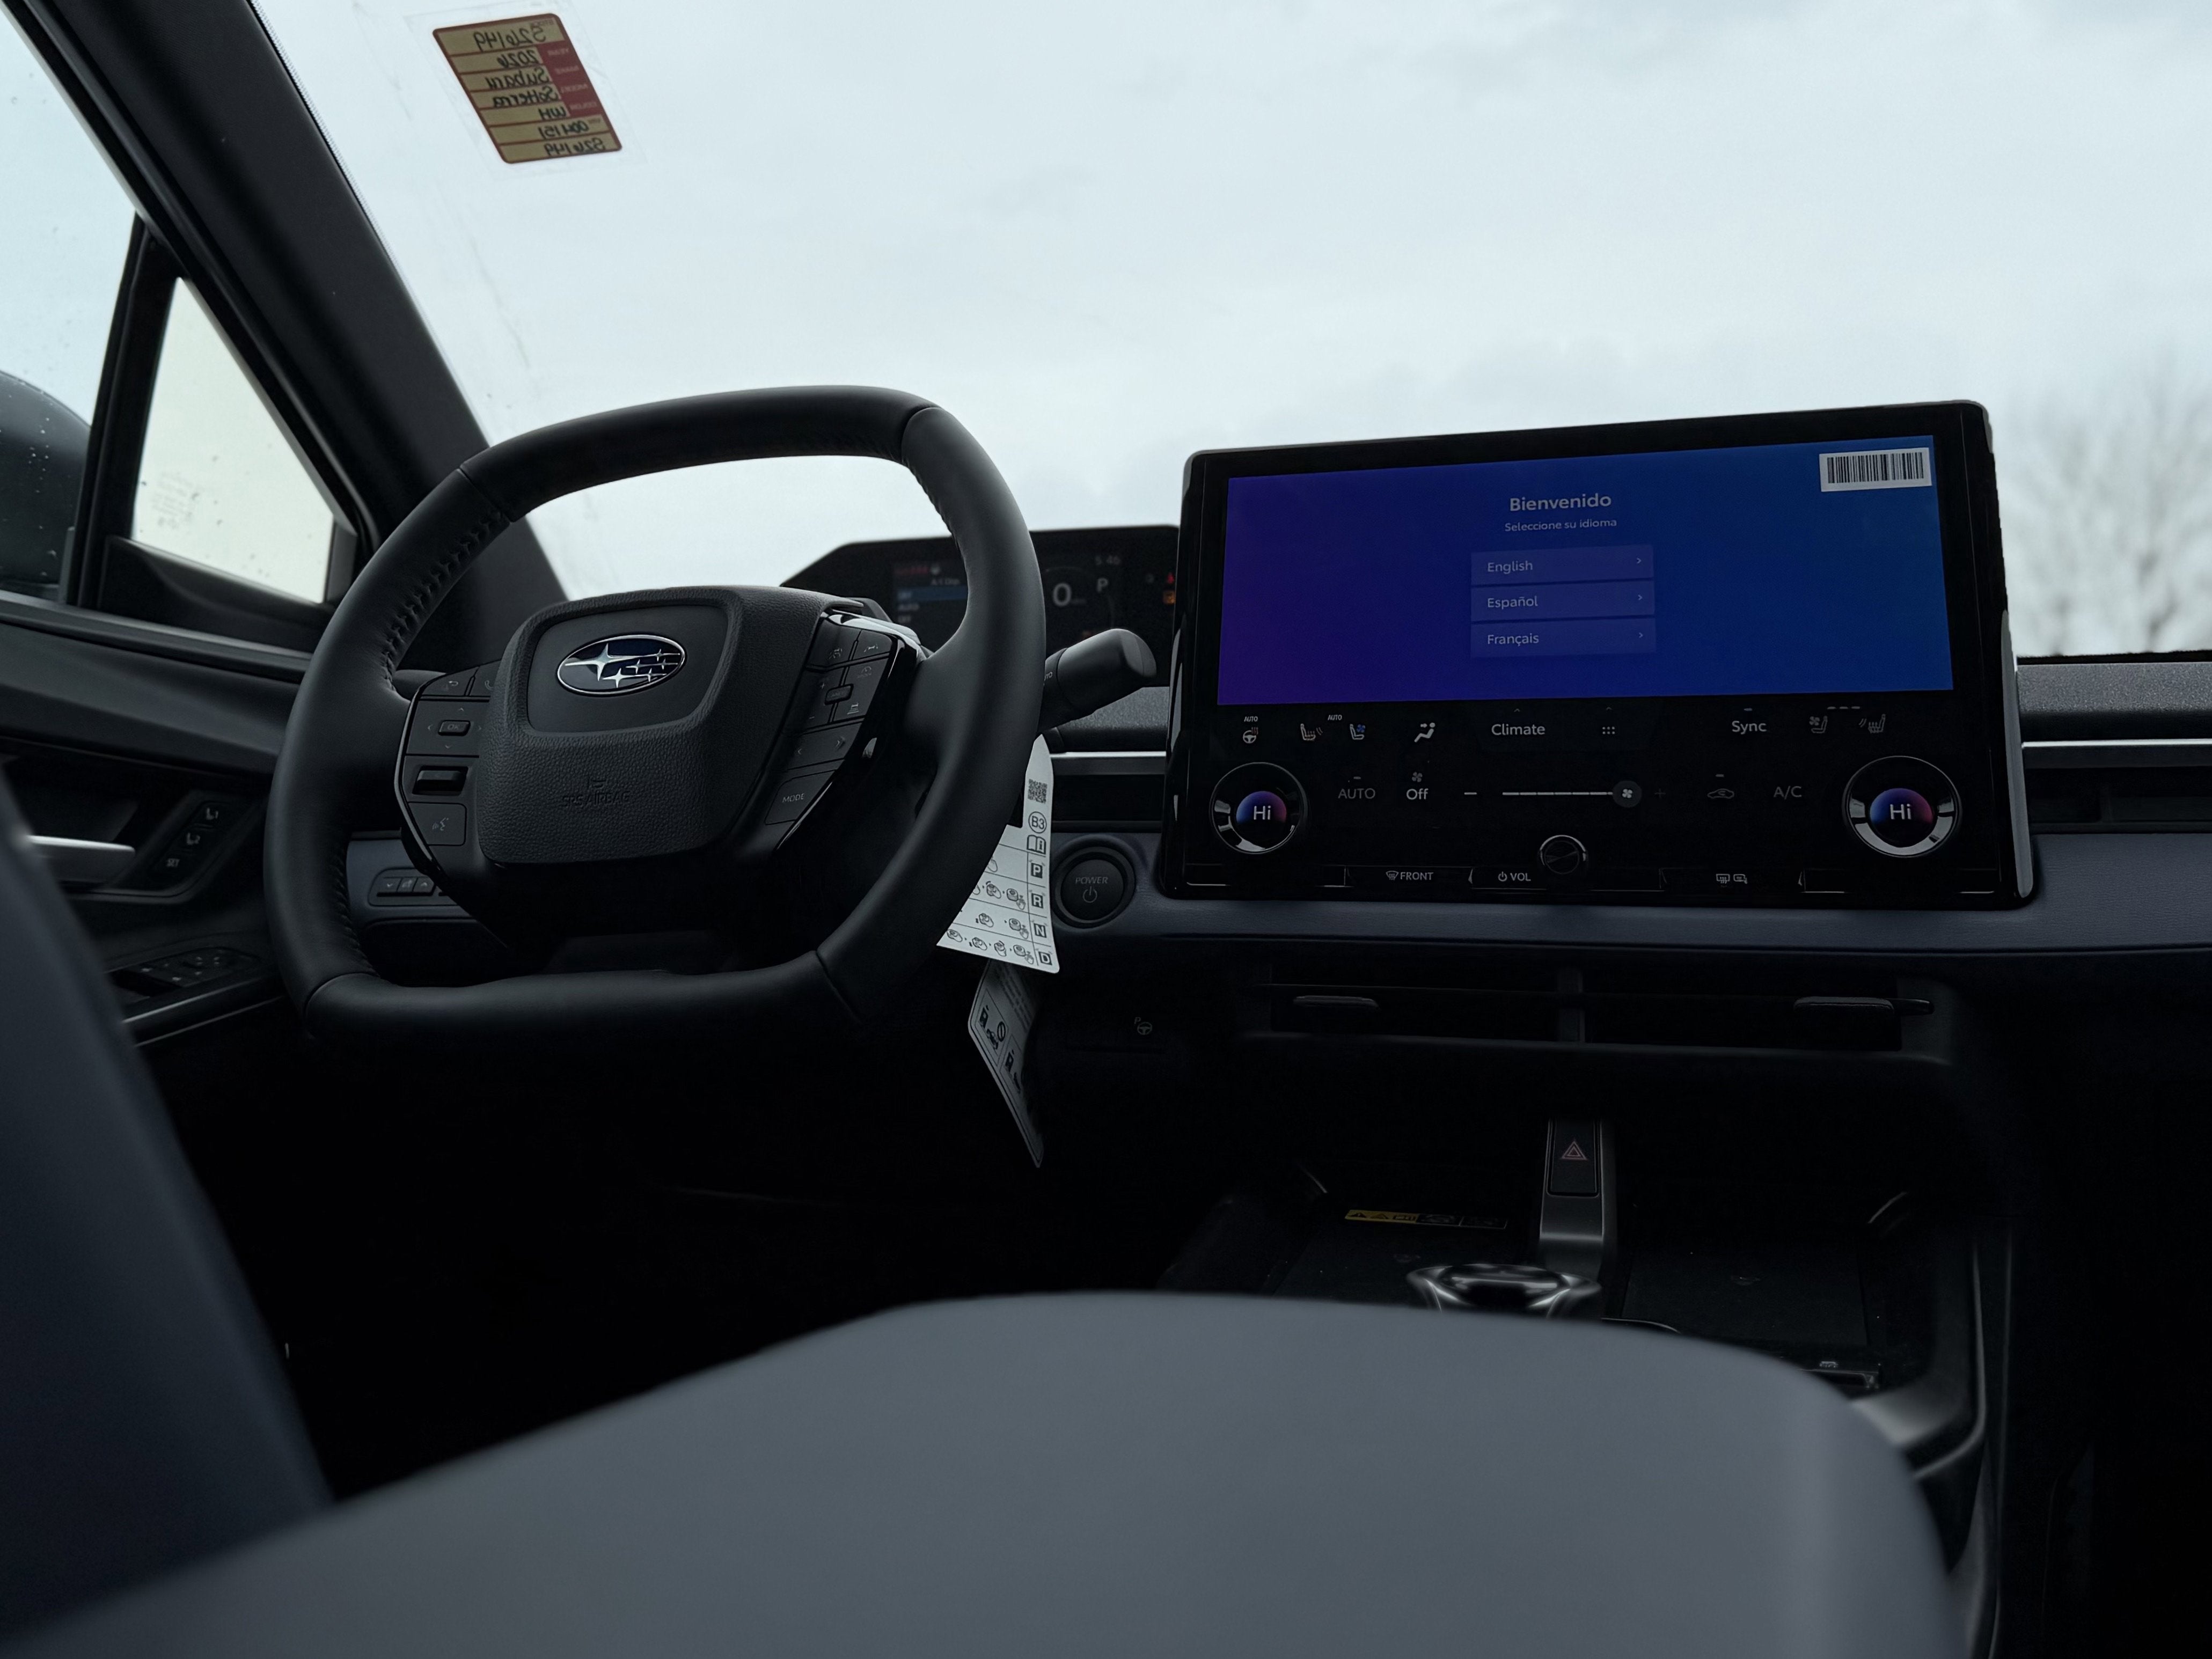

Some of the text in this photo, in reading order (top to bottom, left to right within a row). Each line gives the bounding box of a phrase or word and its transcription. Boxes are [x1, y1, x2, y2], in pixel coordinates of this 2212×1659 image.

[1510, 493, 1612, 511] Bienvenido
[1505, 522, 1562, 532] Seleccione
[1579, 519, 1617, 528] idioma
[1487, 561, 1533, 574] English
[1096, 577, 1109, 593] P
[1487, 596, 1538, 610] Español
[1487, 633, 1539, 646] Français
[1491, 723, 1546, 736] Climate
[1731, 720, 1768, 735] Sync
[782, 793, 805, 804] MODE
[1337, 788, 1376, 799] AUTO
[1406, 788, 1429, 801] Off
[1772, 786, 1803, 801] A/C
[1253, 805, 1271, 821] Hi
[1889, 803, 1912, 820] Hi
[1031, 816, 1045, 830] B3
[1033, 867, 1041, 876] P
[1400, 872, 1434, 880] FRONT
[1510, 872, 1532, 882] VOL
[1075, 876, 1109, 884] POWER
[1034, 896, 1042, 907] R
[1036, 926, 1045, 936] N
